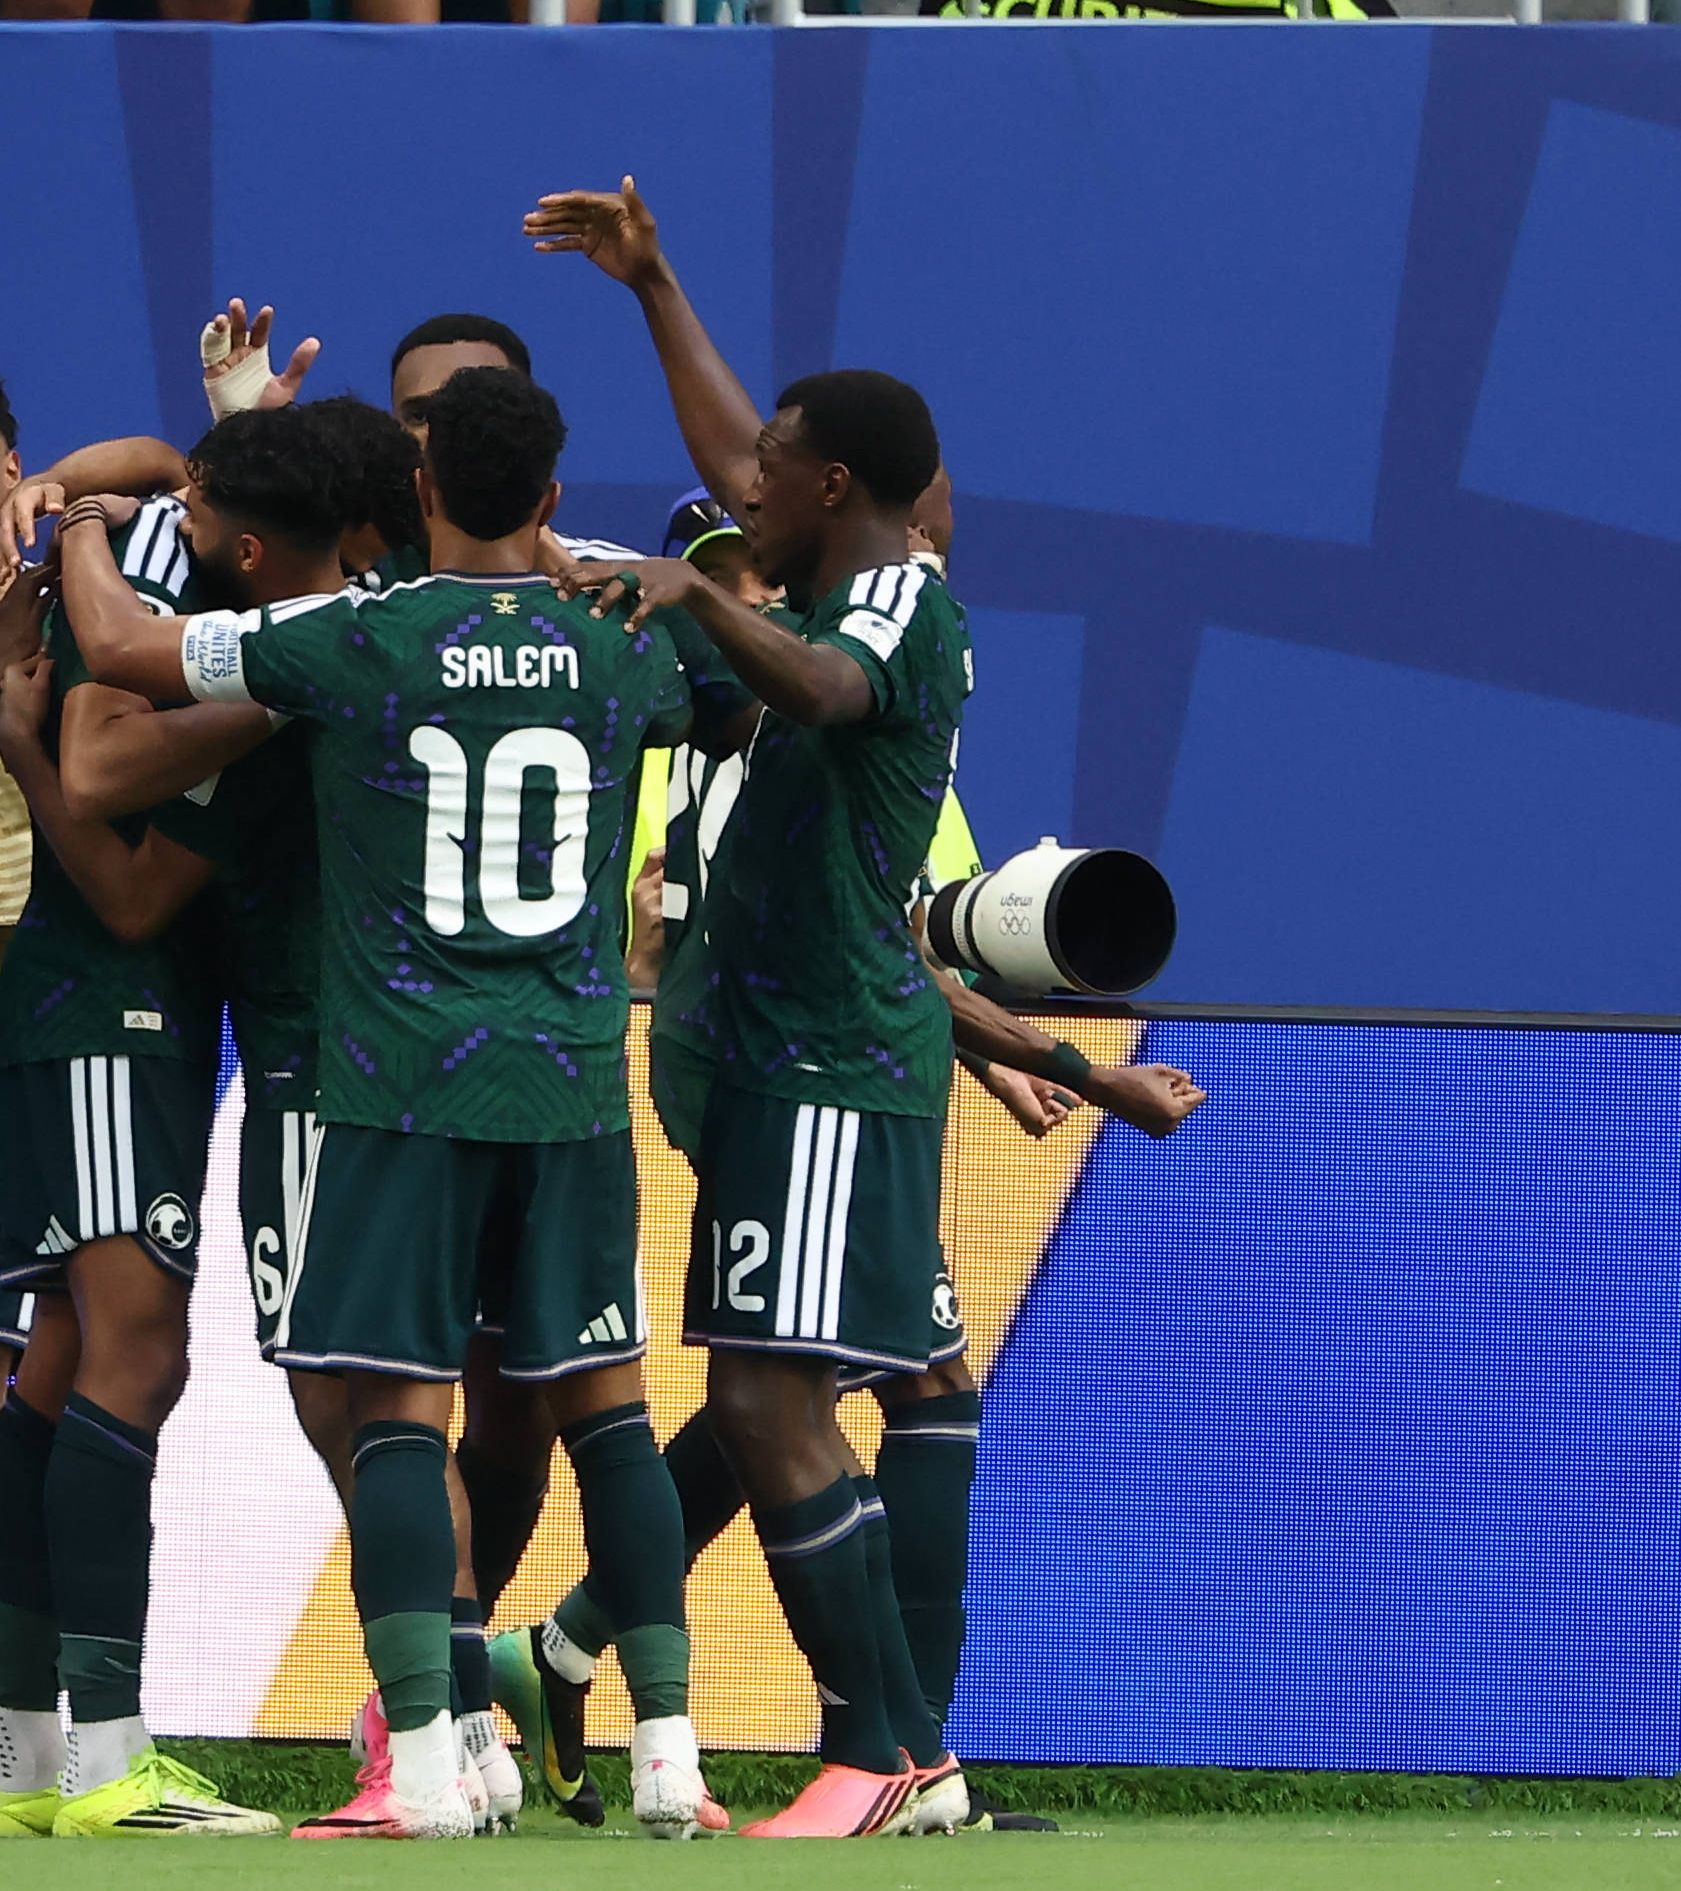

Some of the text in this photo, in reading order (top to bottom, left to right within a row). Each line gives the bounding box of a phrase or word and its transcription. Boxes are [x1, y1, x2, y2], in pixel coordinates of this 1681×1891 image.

[211, 623, 228, 678] UNITES
[441, 645, 580, 690] SALEM
[409, 725, 593, 936] 10
[711, 1219, 770, 1312] 12
